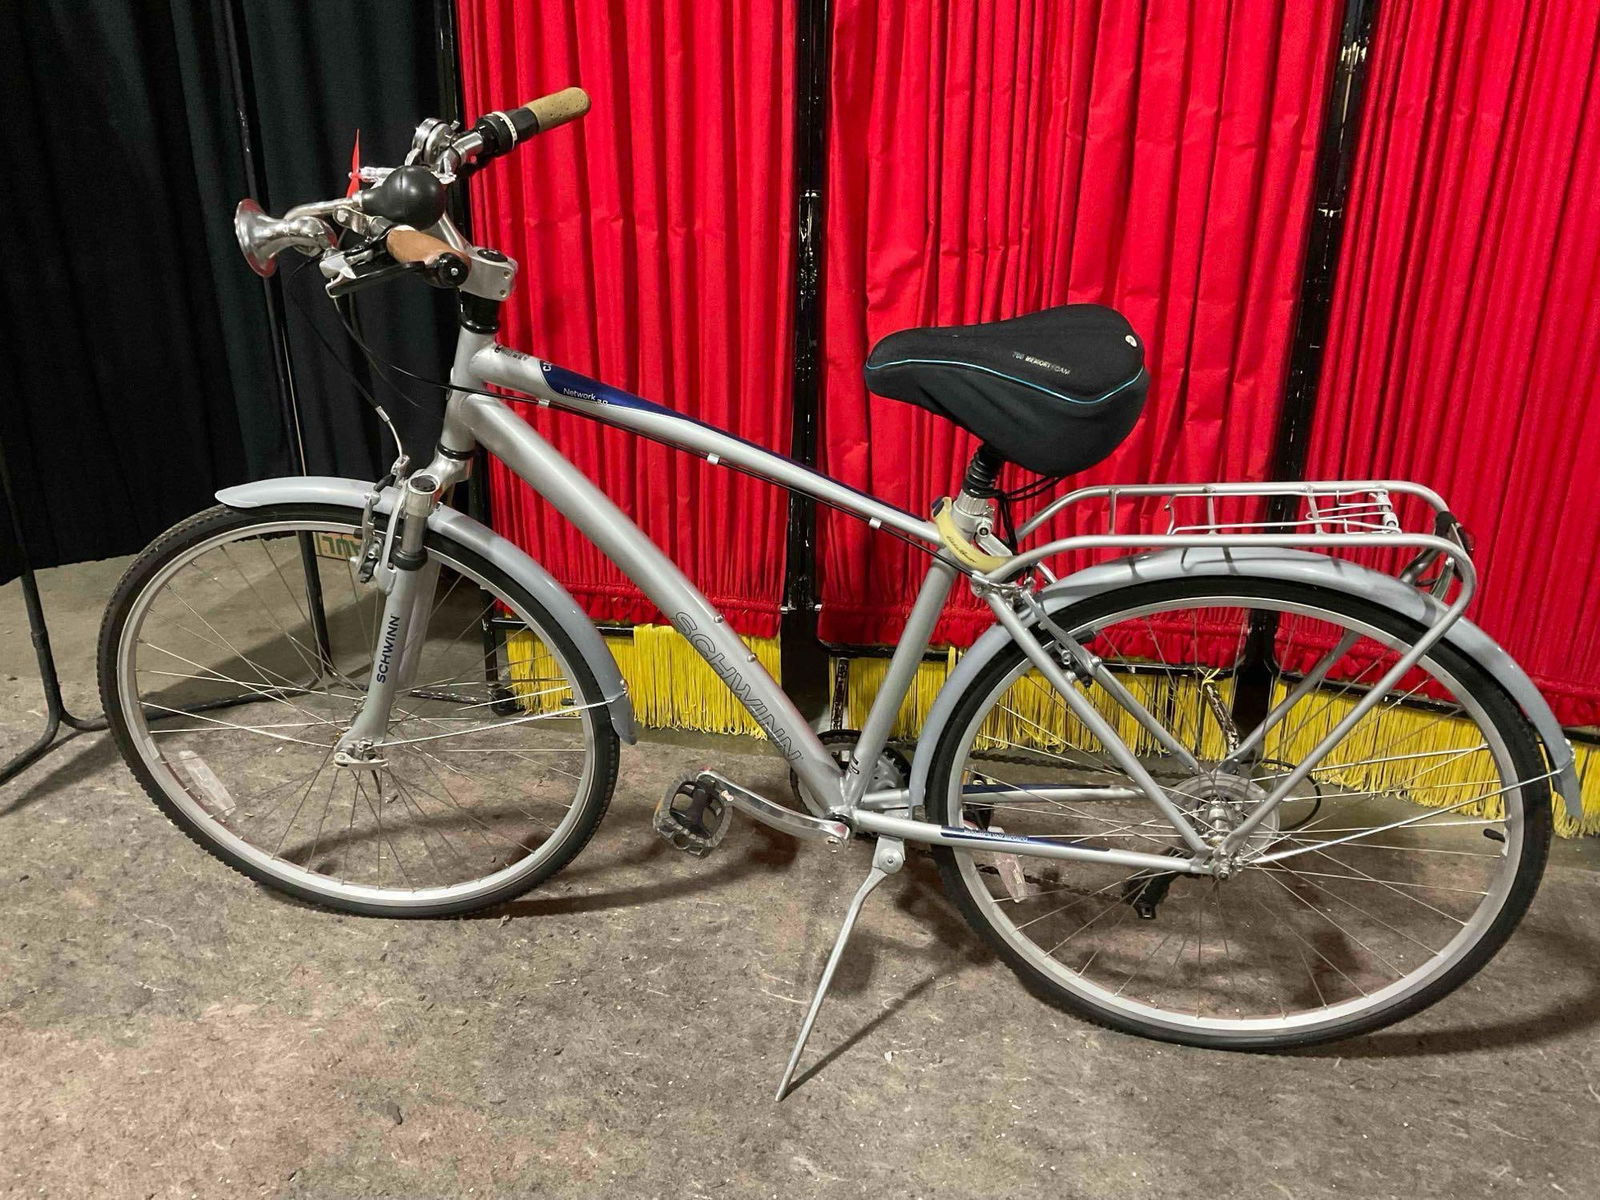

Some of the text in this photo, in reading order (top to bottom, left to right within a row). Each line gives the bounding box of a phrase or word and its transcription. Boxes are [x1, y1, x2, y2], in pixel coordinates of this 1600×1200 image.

[563, 387, 596, 402] Network
[376, 615, 401, 684] SCHWINN
[672, 611, 802, 762] SCHWINN
